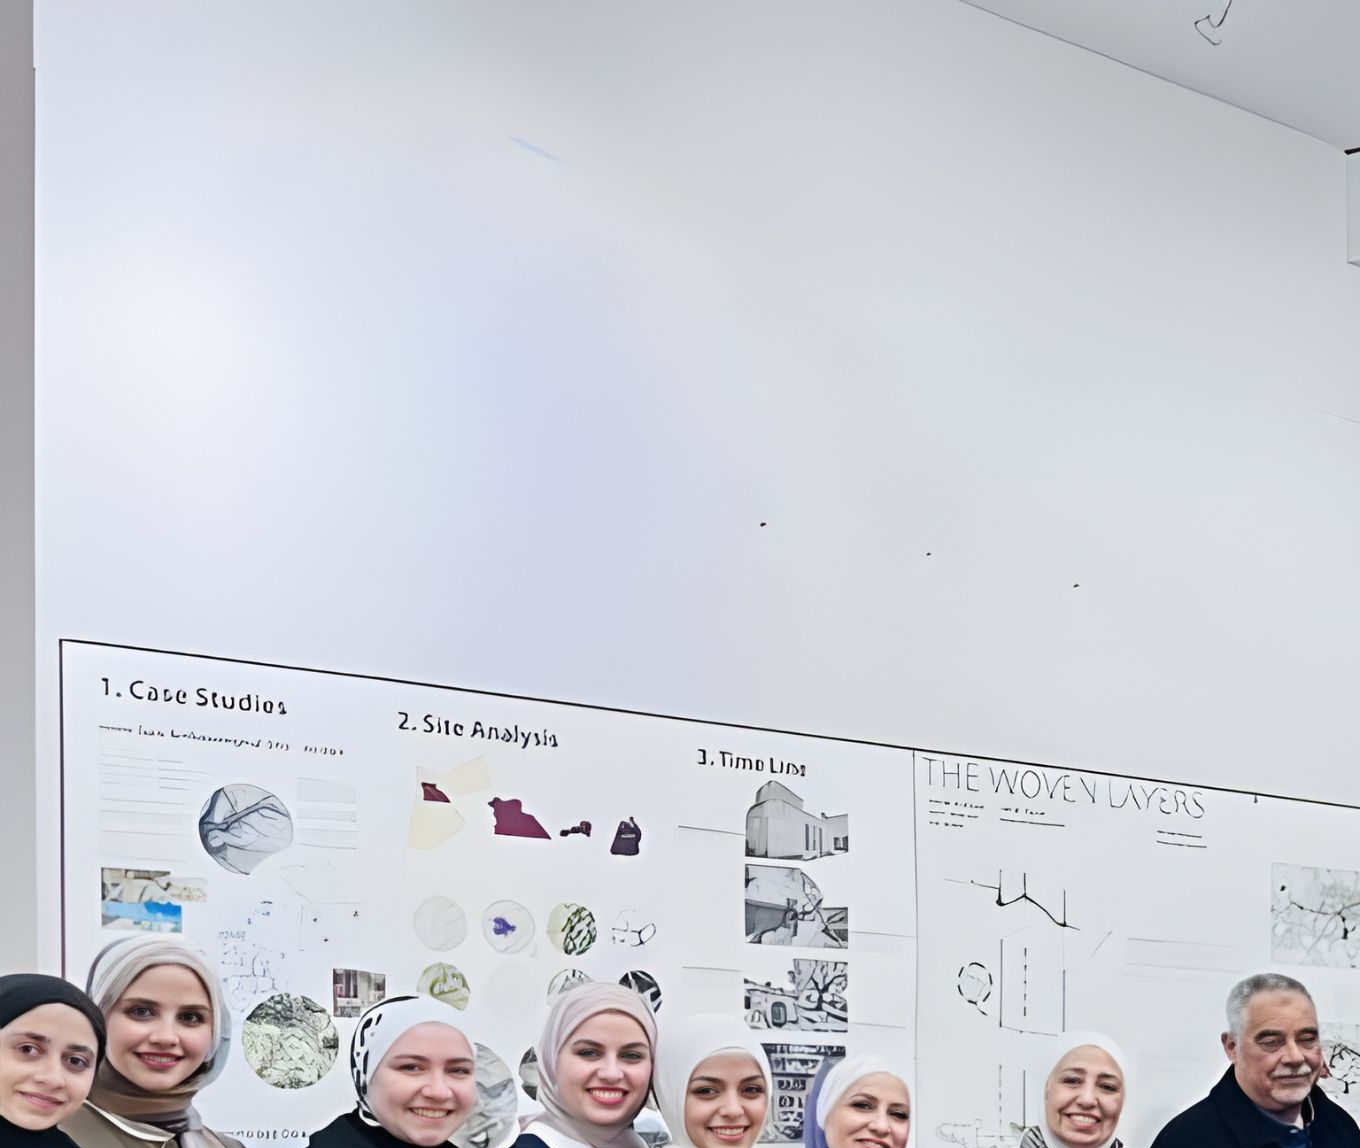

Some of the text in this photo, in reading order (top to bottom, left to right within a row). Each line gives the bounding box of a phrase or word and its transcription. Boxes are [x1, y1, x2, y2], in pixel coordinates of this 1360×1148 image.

[398, 711, 417, 731] 2.
[922, 756, 979, 792] THE
[989, 766, 1096, 804] WOVEN
[1108, 777, 1206, 819] LAYERS
